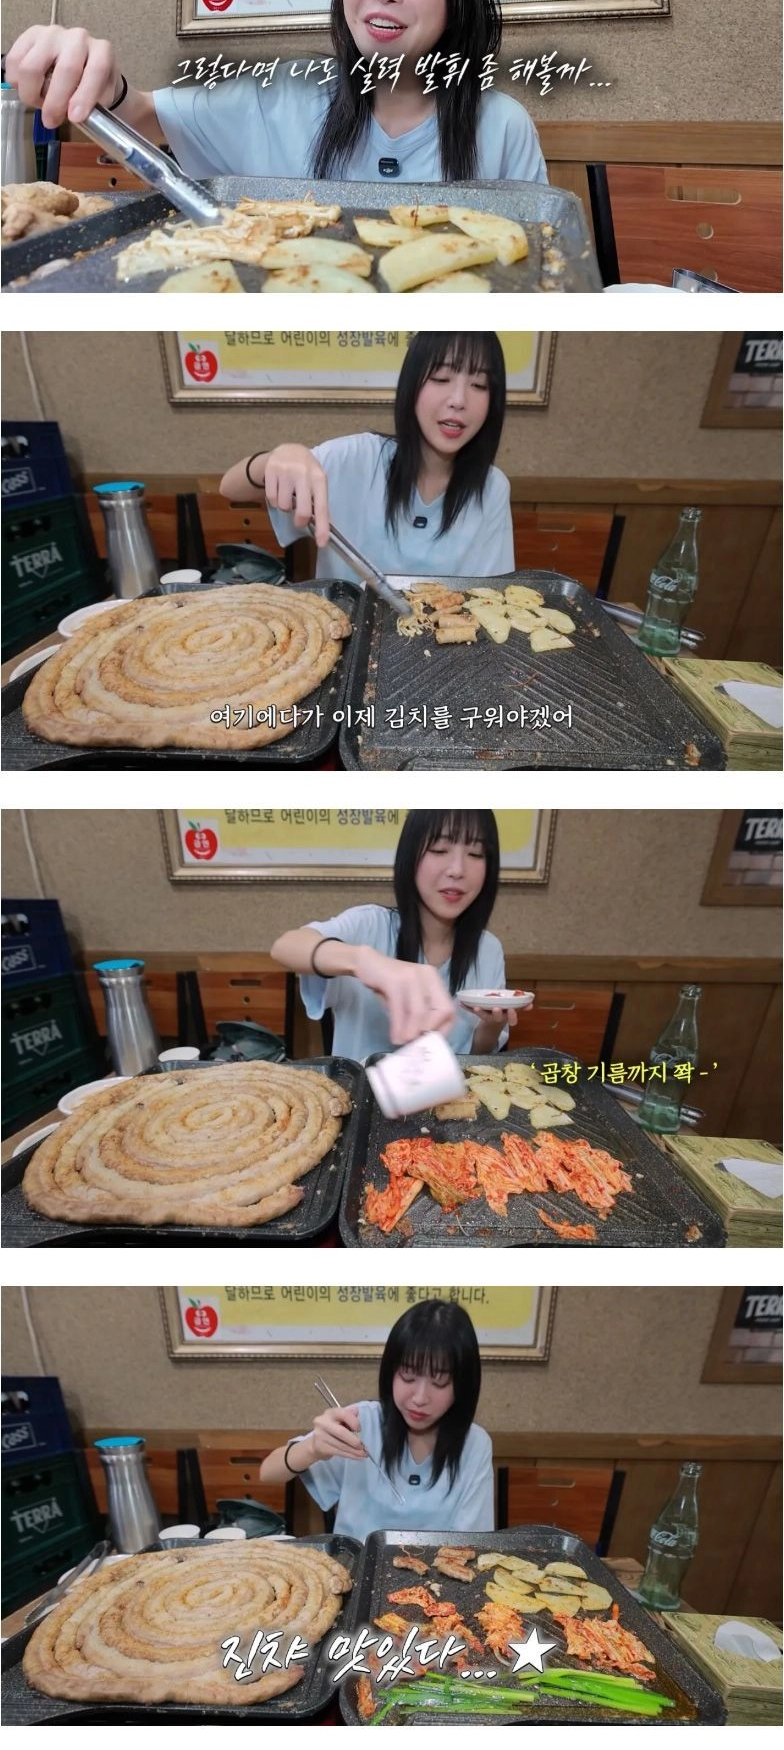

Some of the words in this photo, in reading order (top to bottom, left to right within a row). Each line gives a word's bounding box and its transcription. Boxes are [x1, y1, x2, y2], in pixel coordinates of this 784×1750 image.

[280, 331, 331, 347] 어린이의
[9, 542, 63, 578] TERRA
[10, 1019, 63, 1055] TERRA
[10, 1496, 63, 1533] TERRA
